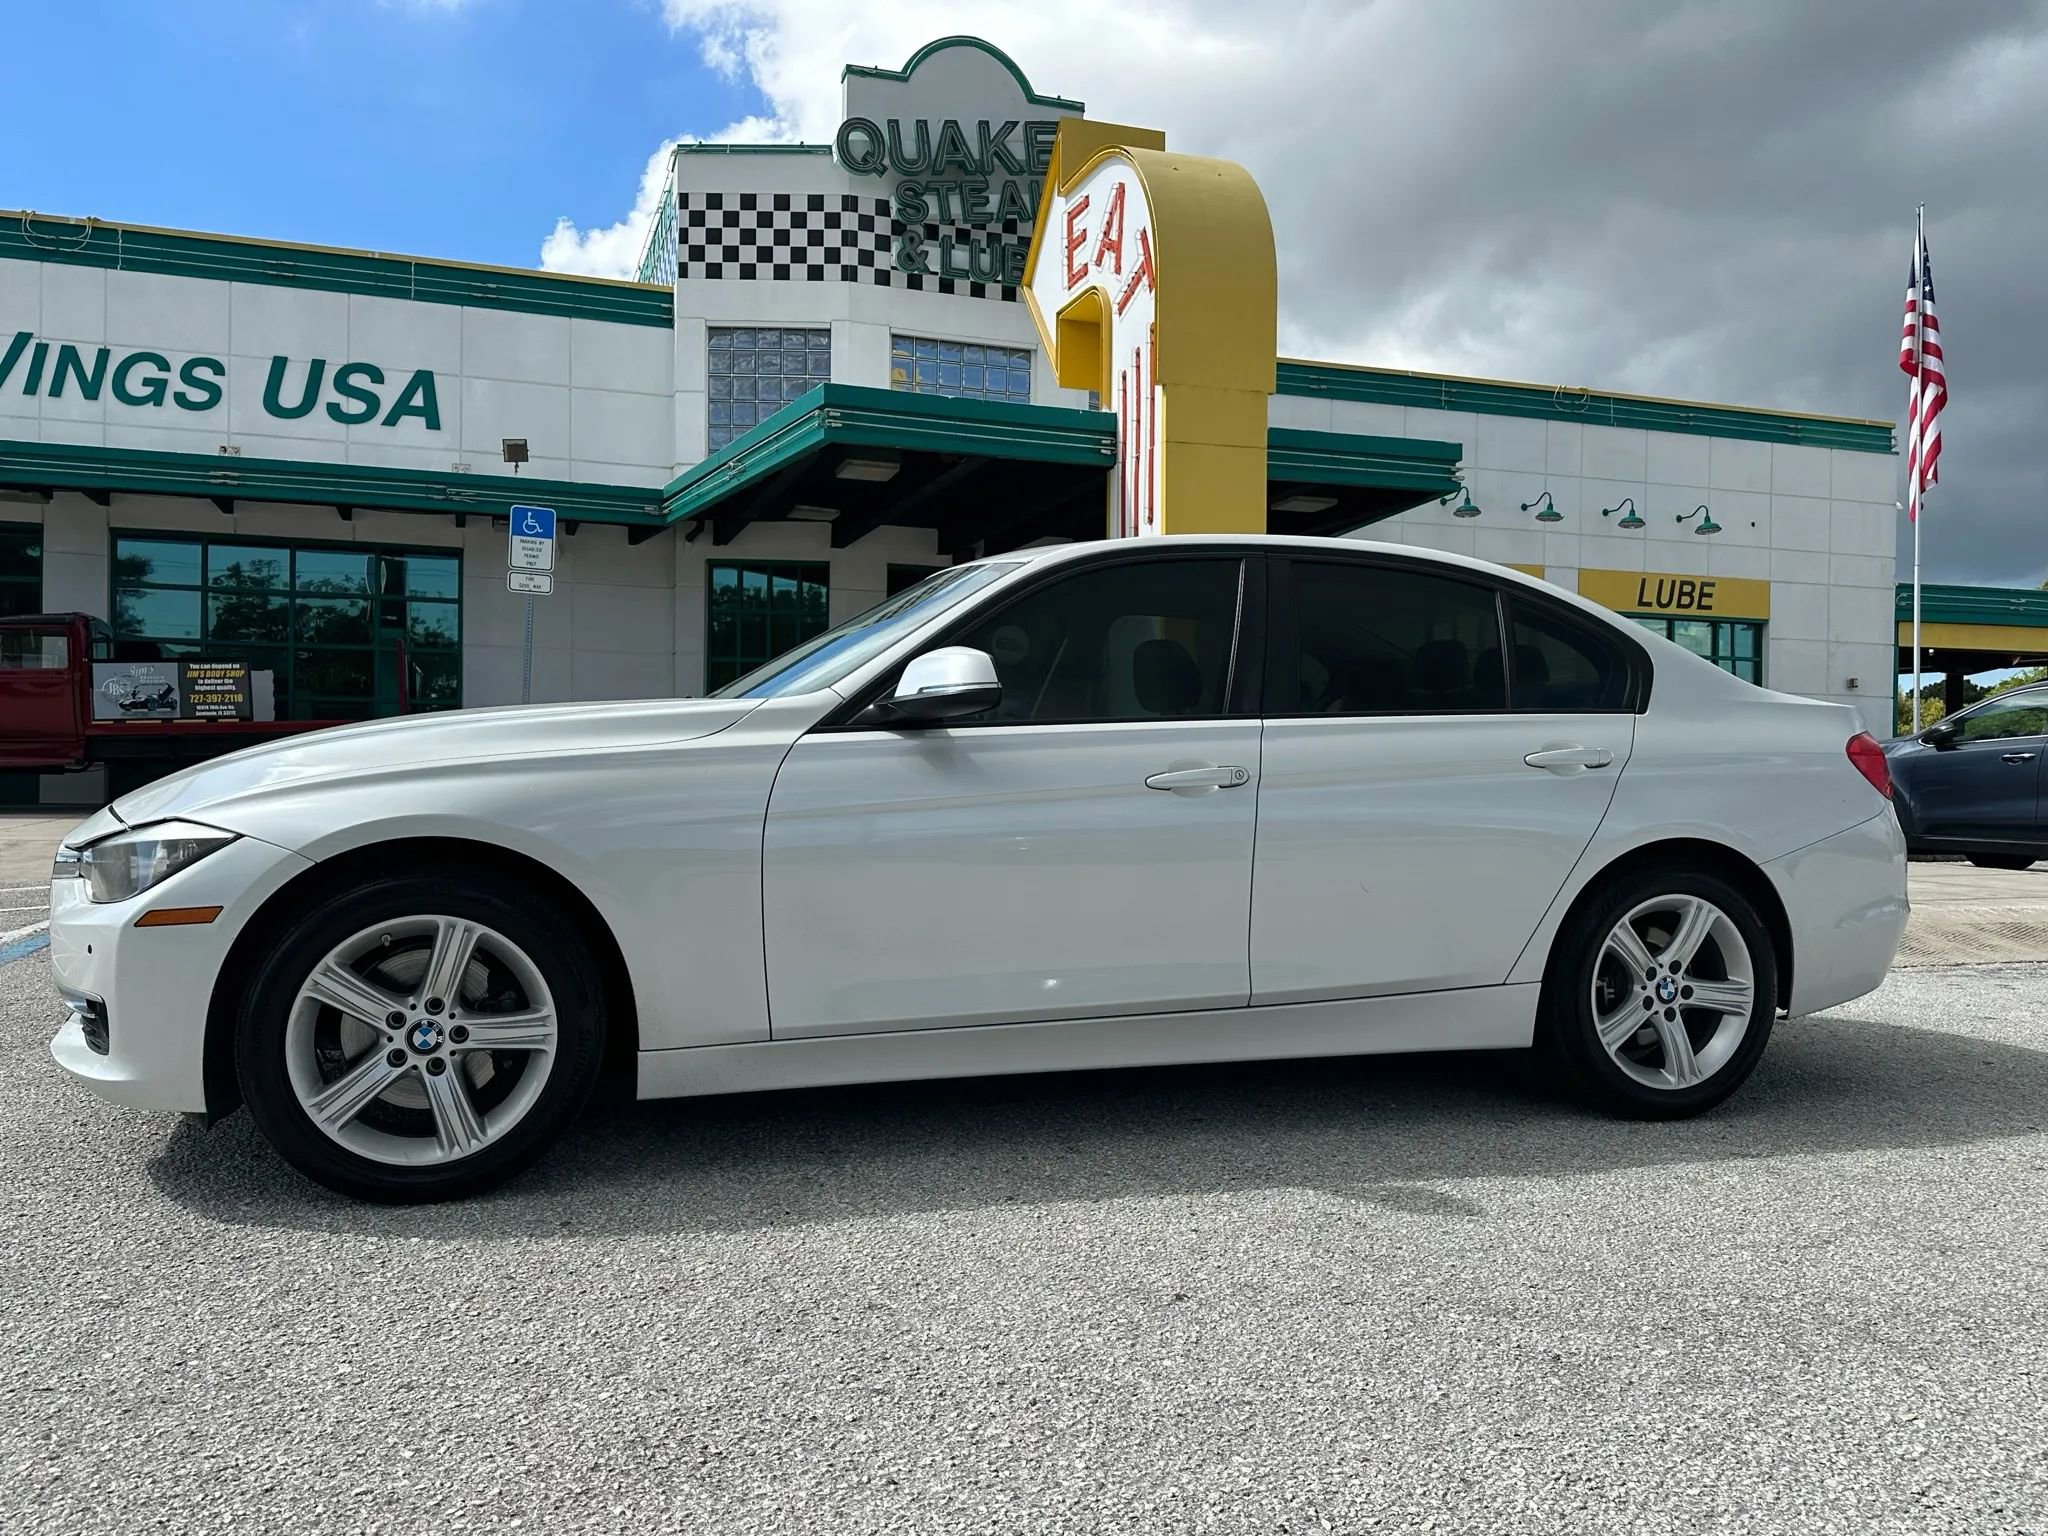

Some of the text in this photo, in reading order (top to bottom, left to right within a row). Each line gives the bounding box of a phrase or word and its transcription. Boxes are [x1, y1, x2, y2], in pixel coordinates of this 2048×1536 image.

[896, 230, 931, 274] &
[1063, 182, 1156, 317] EAT
[263, 356, 441, 431] USA
[1637, 578, 1716, 611] LUBE
[187, 670, 245, 678] JIM'S BODY SHOP
[211, 662, 232, 670] depend
[189, 693, 244, 703] 727-397-2118
